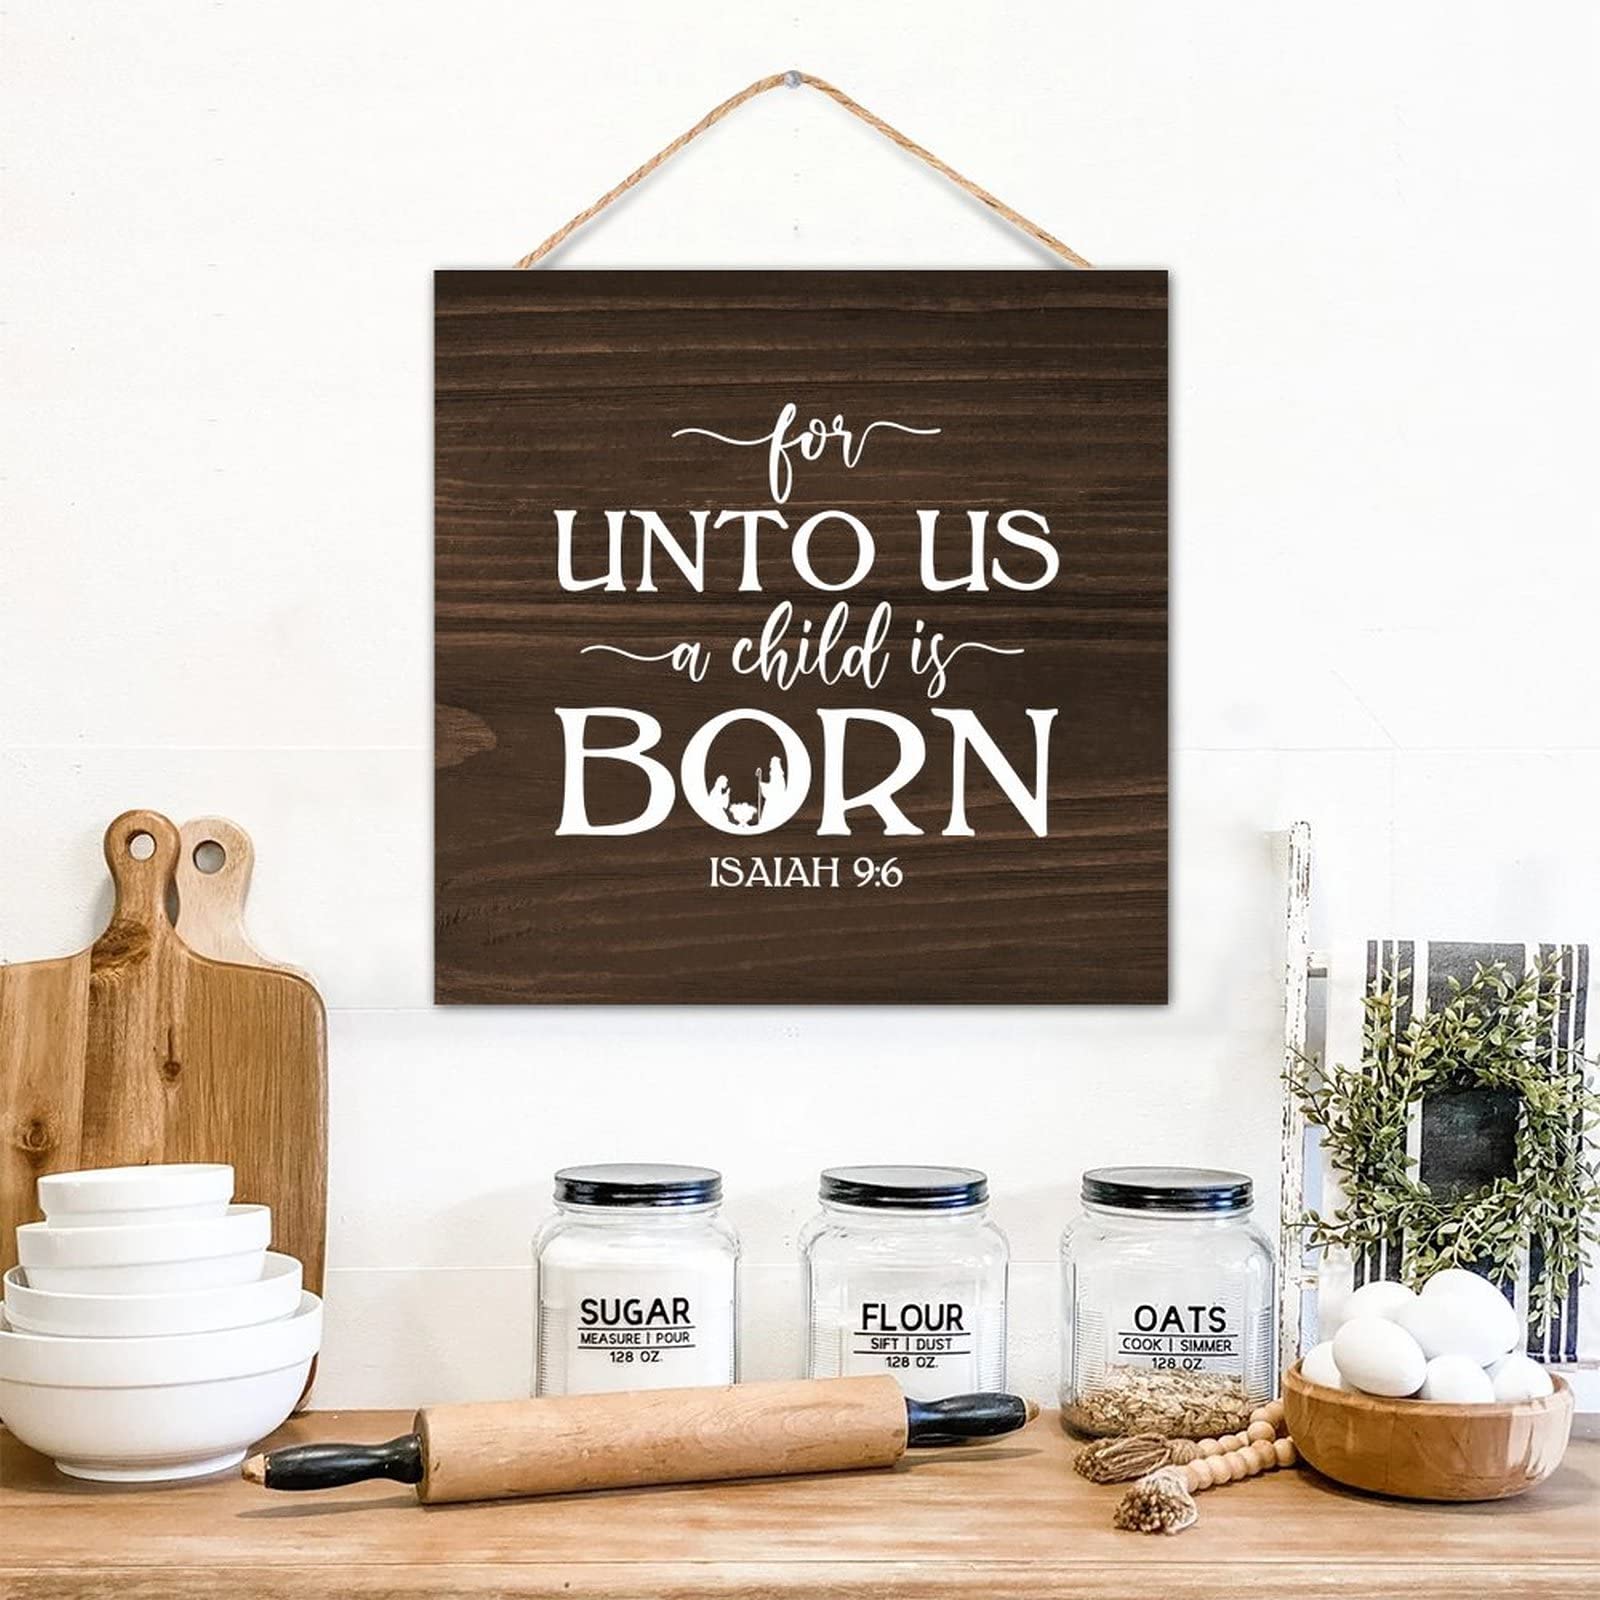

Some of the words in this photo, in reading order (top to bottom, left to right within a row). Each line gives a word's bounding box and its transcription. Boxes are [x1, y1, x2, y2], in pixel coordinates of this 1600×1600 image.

[553, 509, 876, 593] UNTO
[916, 509, 1060, 592] US
[731, 600, 892, 691] child
[554, 706, 1059, 838] BORN
[709, 856, 840, 888] ISAIAH
[853, 856, 904, 888] 9:6
[580, 1297, 691, 1326] SUGAR
[862, 1303, 964, 1332] FLOUR
[1134, 1304, 1226, 1334] OATS
[580, 1332, 641, 1345] MEASURE
[656, 1331, 690, 1344] POUR
[870, 1337, 899, 1350] SIFT
[916, 1337, 952, 1351] DUST
[1122, 1337, 1162, 1351] COOK
[1180, 1339, 1232, 1353] SIMMER
[609, 1350, 634, 1363] 128
[886, 1356, 910, 1369] 128
[1151, 1357, 1177, 1370] 128
